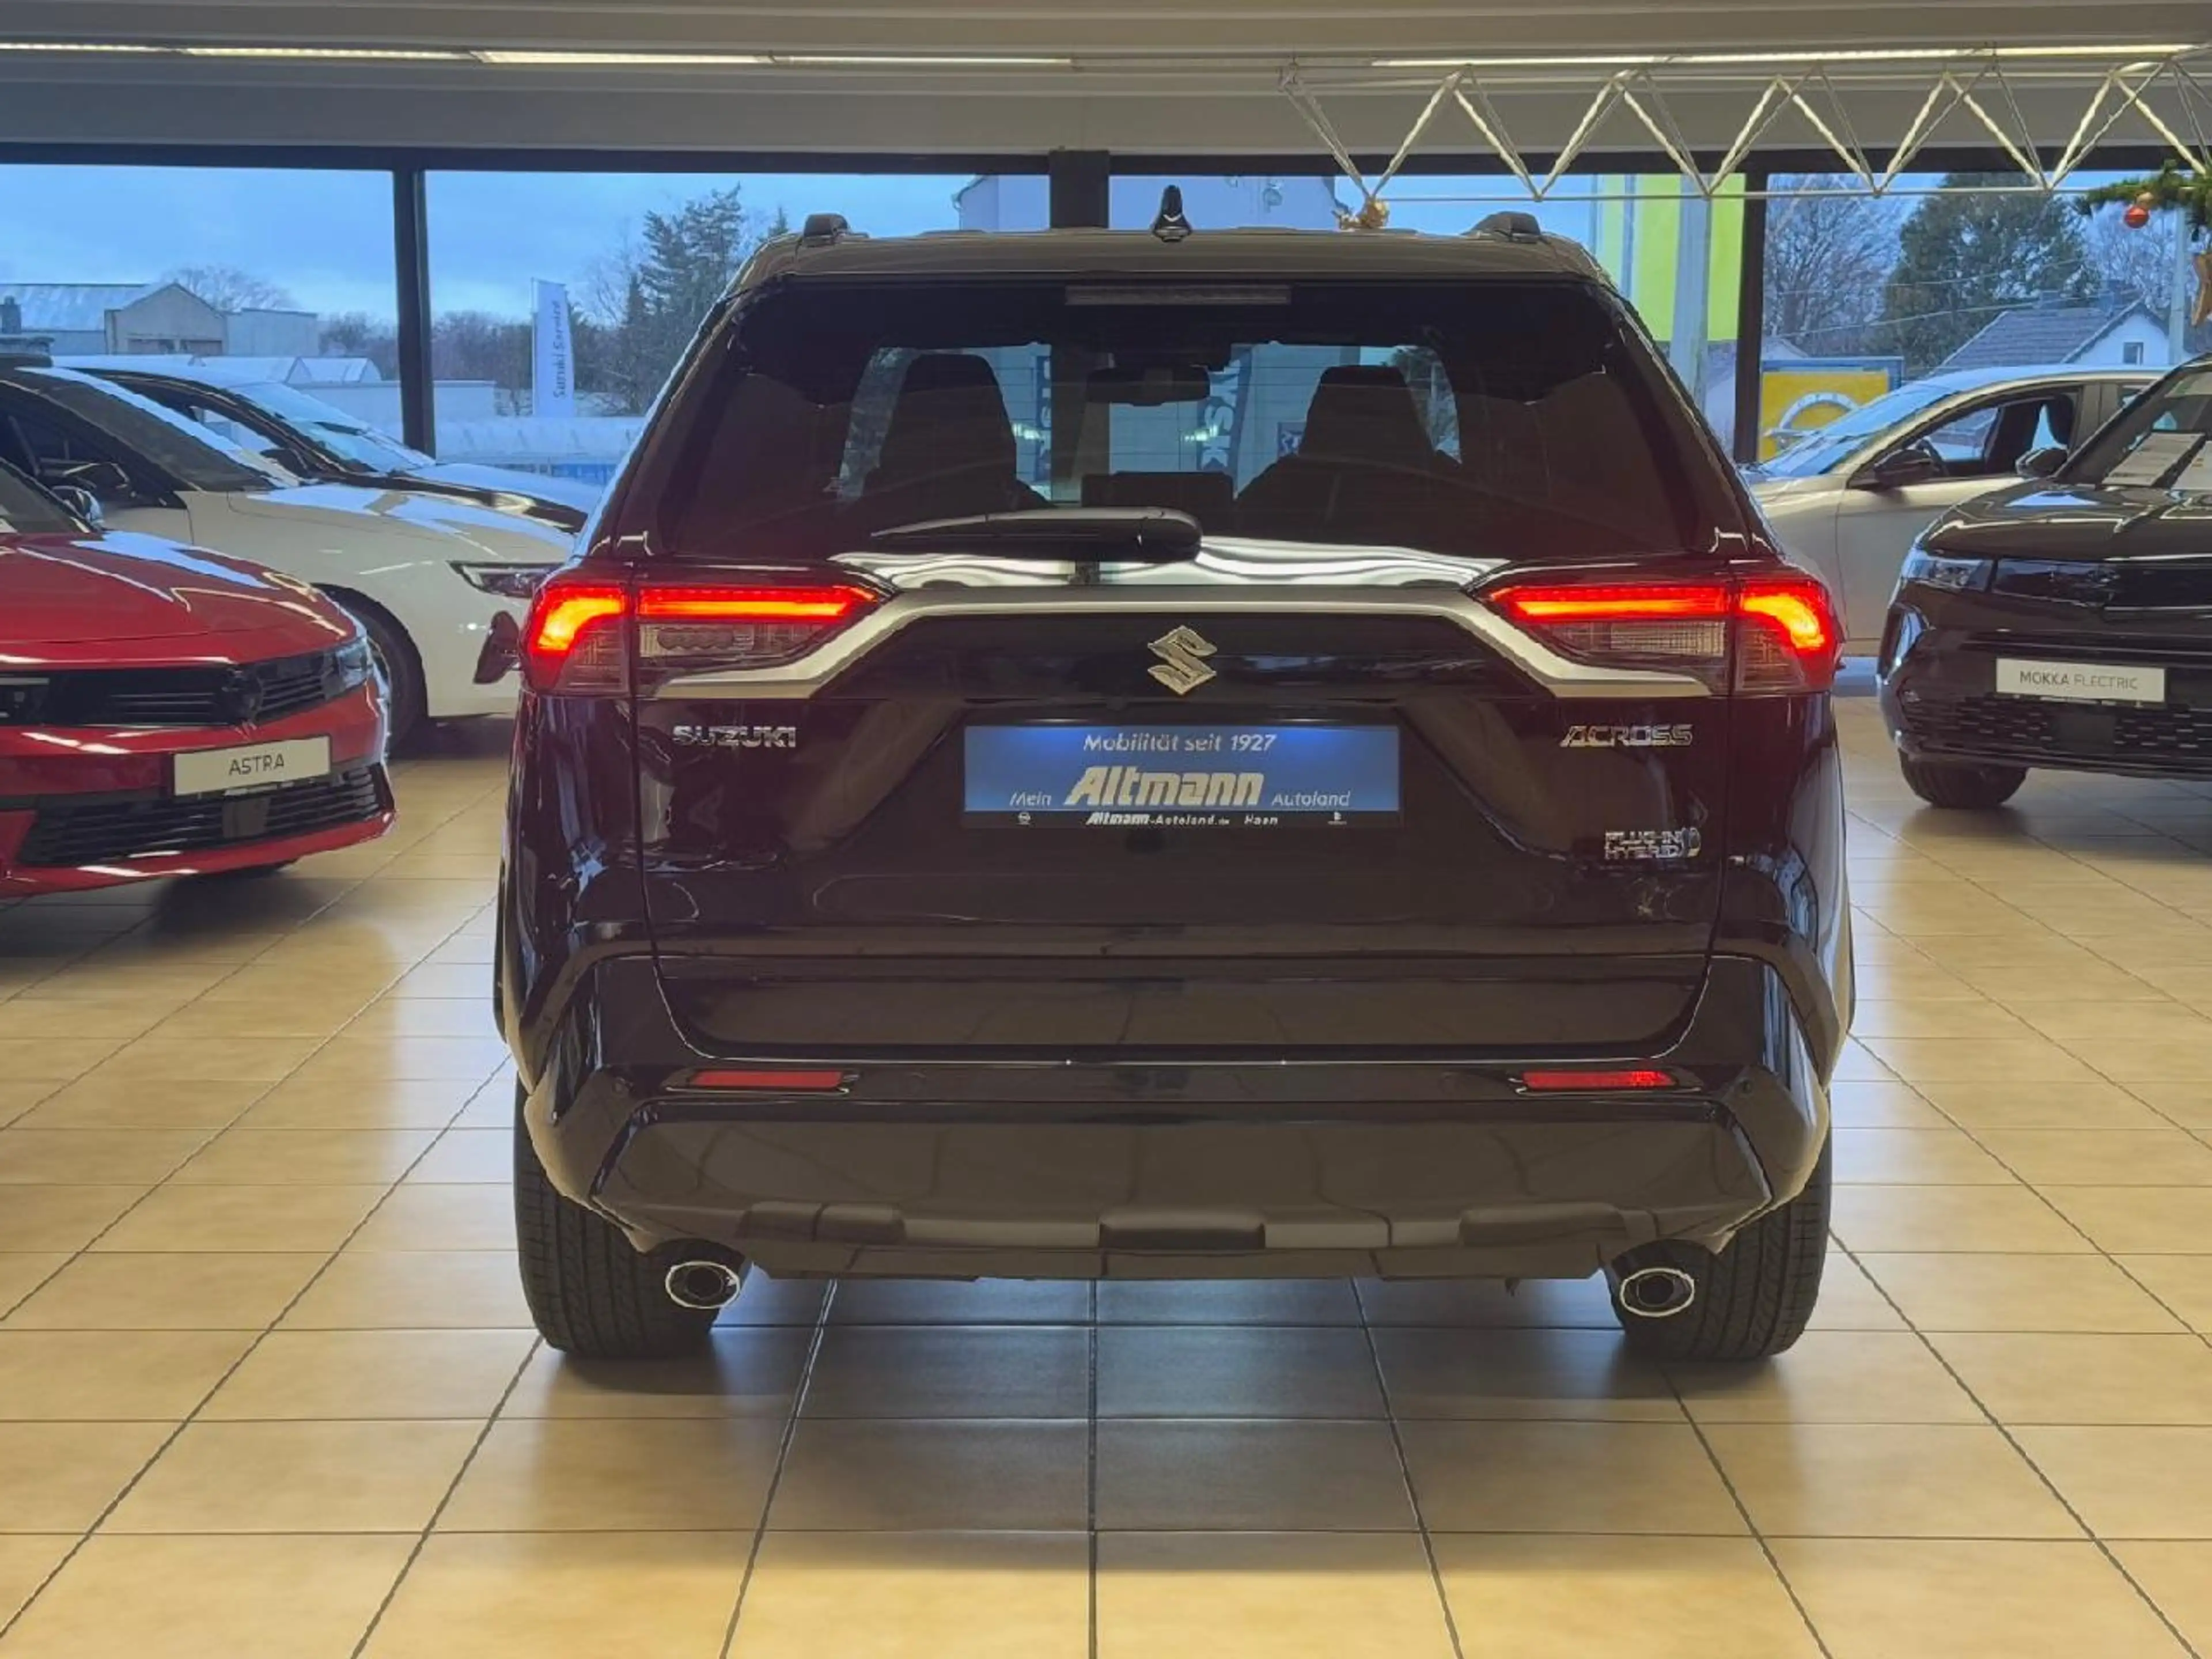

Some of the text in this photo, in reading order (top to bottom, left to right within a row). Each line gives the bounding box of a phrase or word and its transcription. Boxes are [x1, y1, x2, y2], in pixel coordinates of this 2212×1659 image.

[2020, 671, 2138, 690] MOKKA ELECTRIC
[672, 725, 796, 748] SUZUKI
[1083, 733, 1277, 751] Mobilität seit 1927
[1559, 724, 1694, 747] ACROSS
[229, 753, 285, 777] ASTRA
[1009, 766, 1351, 806] Mein Altmann Autoland
[1605, 830, 1683, 844] PLUG-IN
[1604, 844, 1683, 860] HYBRID
